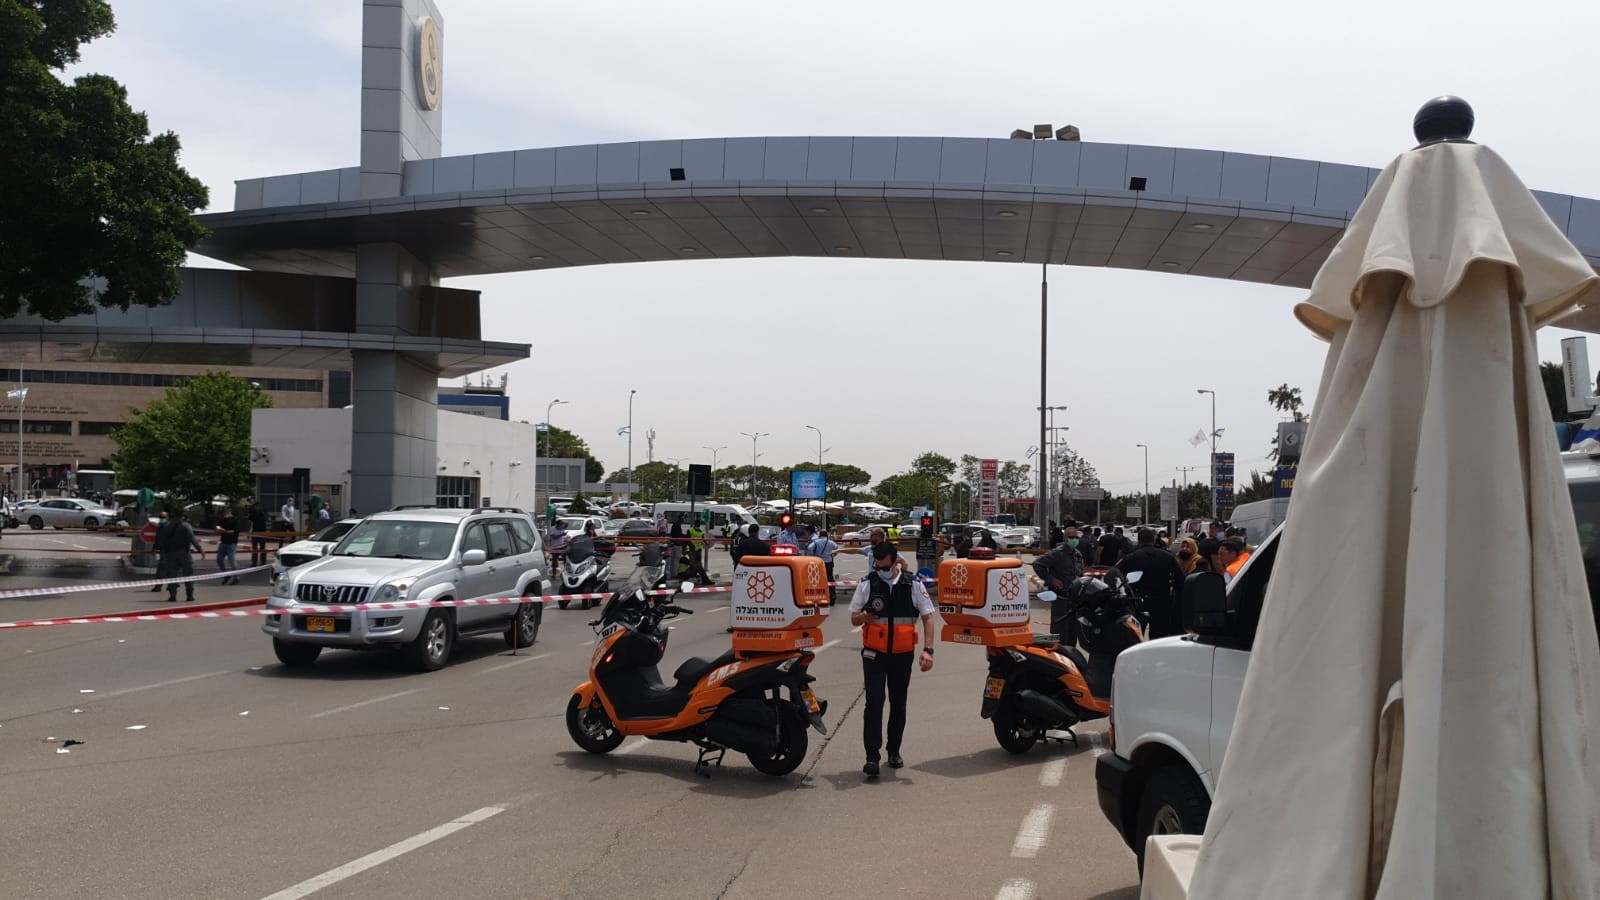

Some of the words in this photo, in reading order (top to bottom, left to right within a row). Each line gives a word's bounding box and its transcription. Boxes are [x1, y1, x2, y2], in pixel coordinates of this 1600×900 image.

[735, 605, 759, 615] הצלה
[759, 606, 784, 615] איחוד
[991, 604, 1010, 612] הצלה
[1012, 603, 1028, 611] איחוד
[602, 625, 617, 638] 1077
